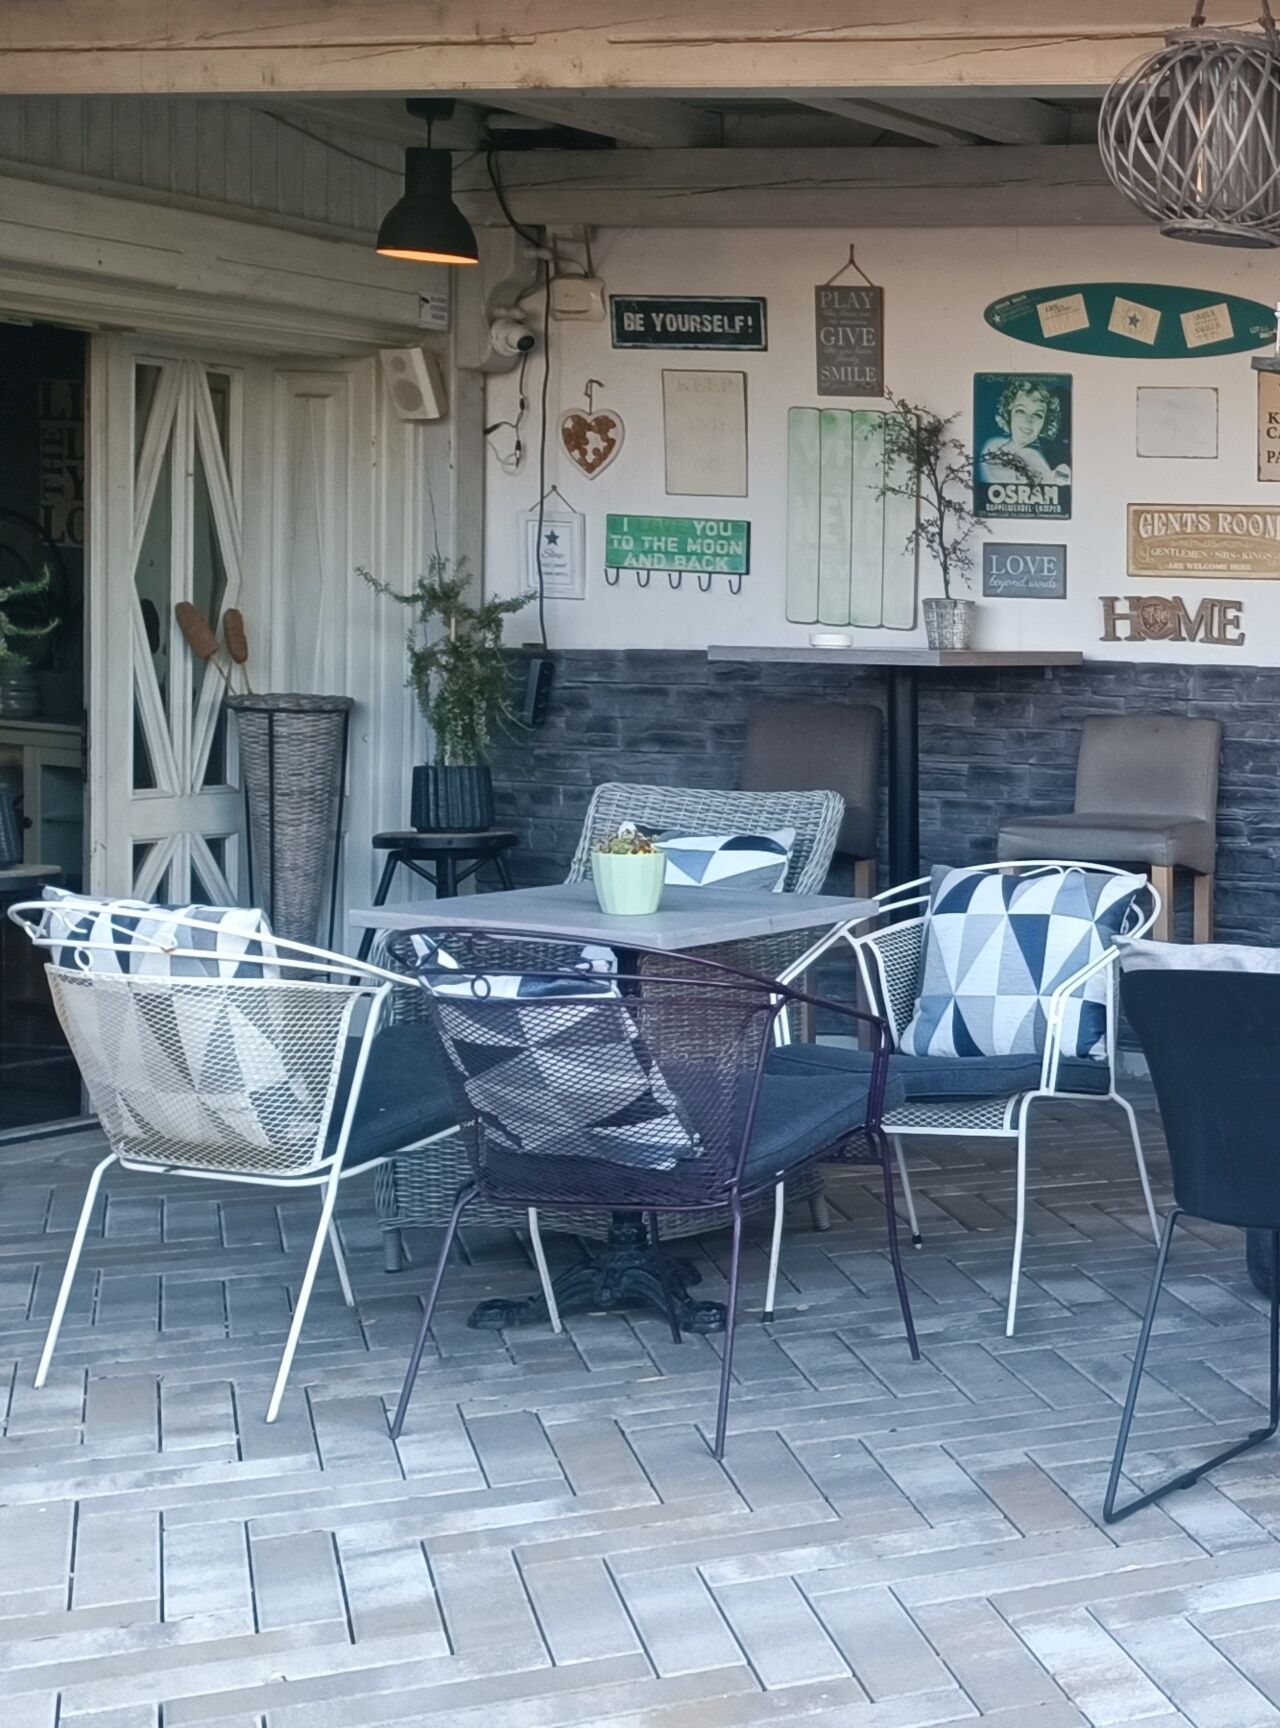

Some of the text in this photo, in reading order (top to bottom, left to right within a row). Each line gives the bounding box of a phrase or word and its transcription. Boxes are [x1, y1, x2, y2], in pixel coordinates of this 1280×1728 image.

[820, 291, 874, 309] PLAY
[624, 312, 753, 334] BE YOURSELF!
[820, 326, 876, 346] GIVE
[820, 366, 877, 382] SMILE
[987, 484, 1058, 505] OSRAM
[623, 517, 628, 532] I
[692, 521, 732, 537] YOU
[1139, 512, 1211, 538] GENTS
[609, 534, 742, 555] TO THE MOON
[1151, 547, 1208, 559] GENTLEMEN
[1242, 552, 1274, 561] KINGS
[624, 552, 729, 570] AND BACK
[990, 554, 1057, 576] LOVE
[989, 575, 1027, 593] beyond
[1098, 595, 1245, 646] HOME
